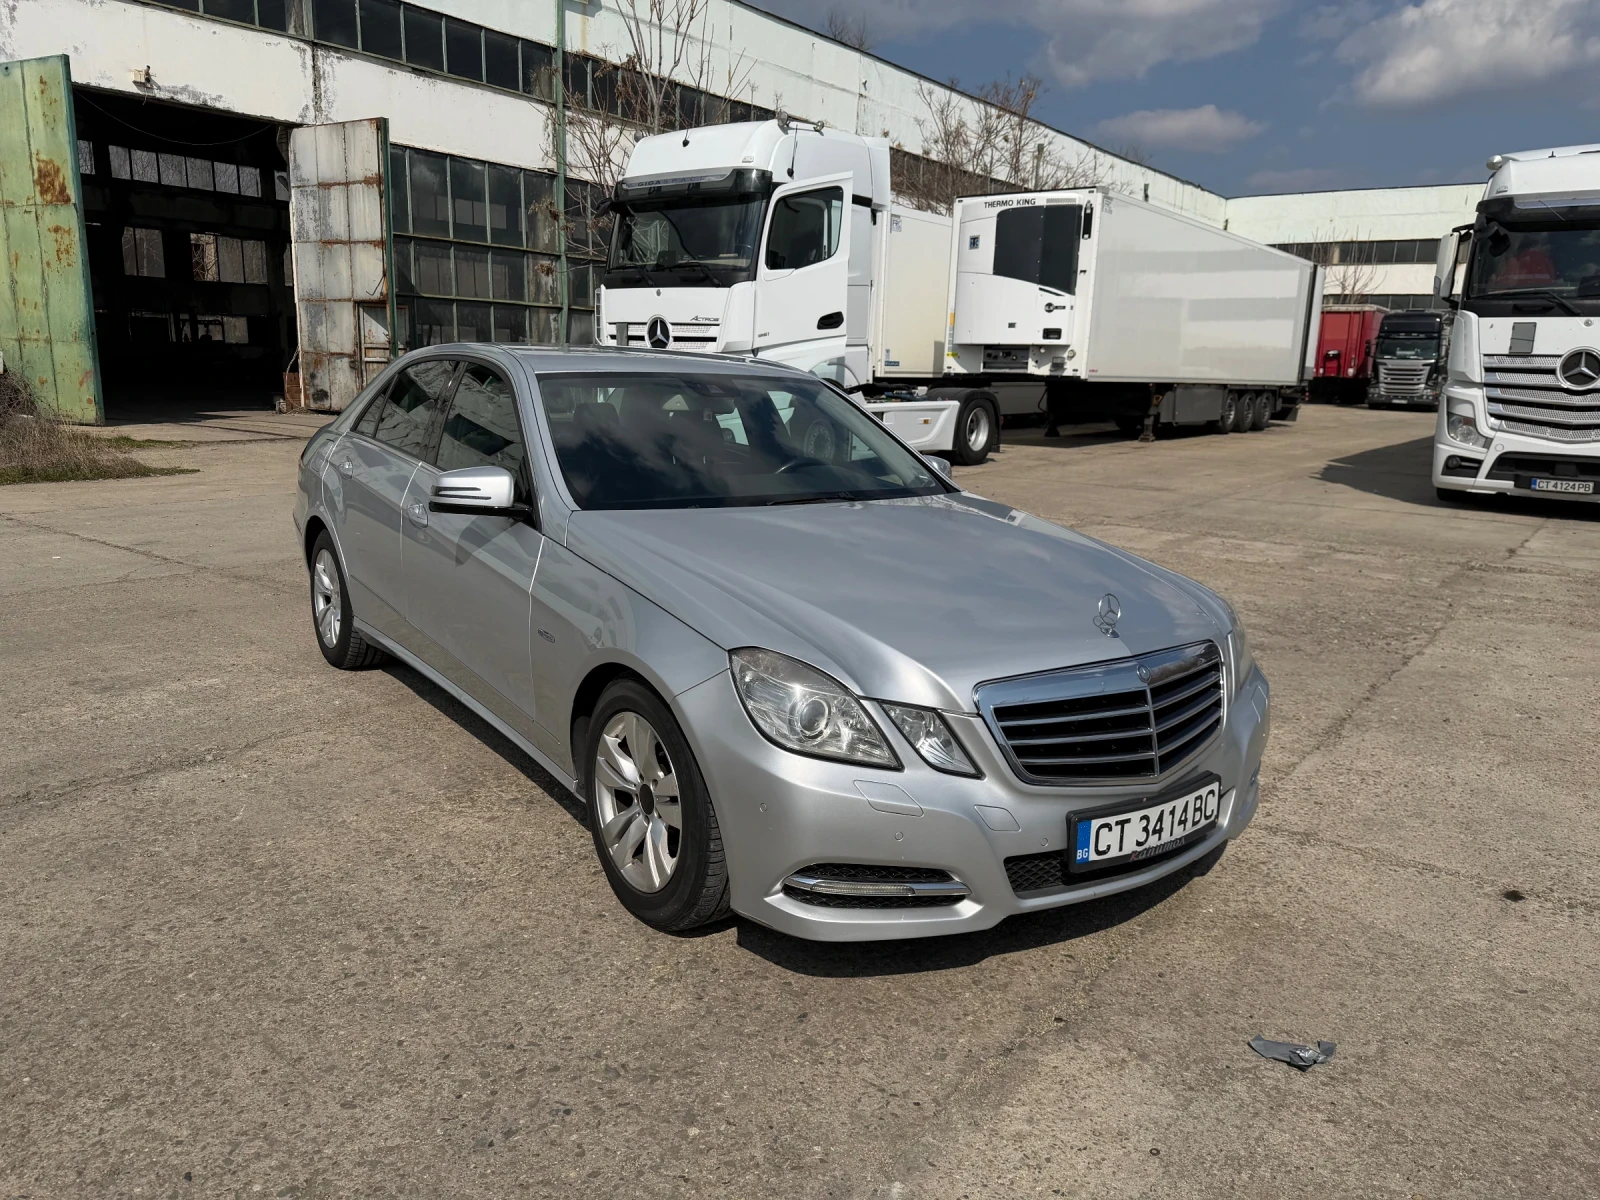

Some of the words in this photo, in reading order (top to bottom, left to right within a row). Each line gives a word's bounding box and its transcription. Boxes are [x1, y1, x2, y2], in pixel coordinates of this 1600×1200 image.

[984, 199, 1014, 209] THERMO
[1016, 198, 1036, 206] KING
[1076, 848, 1089, 860] BG
